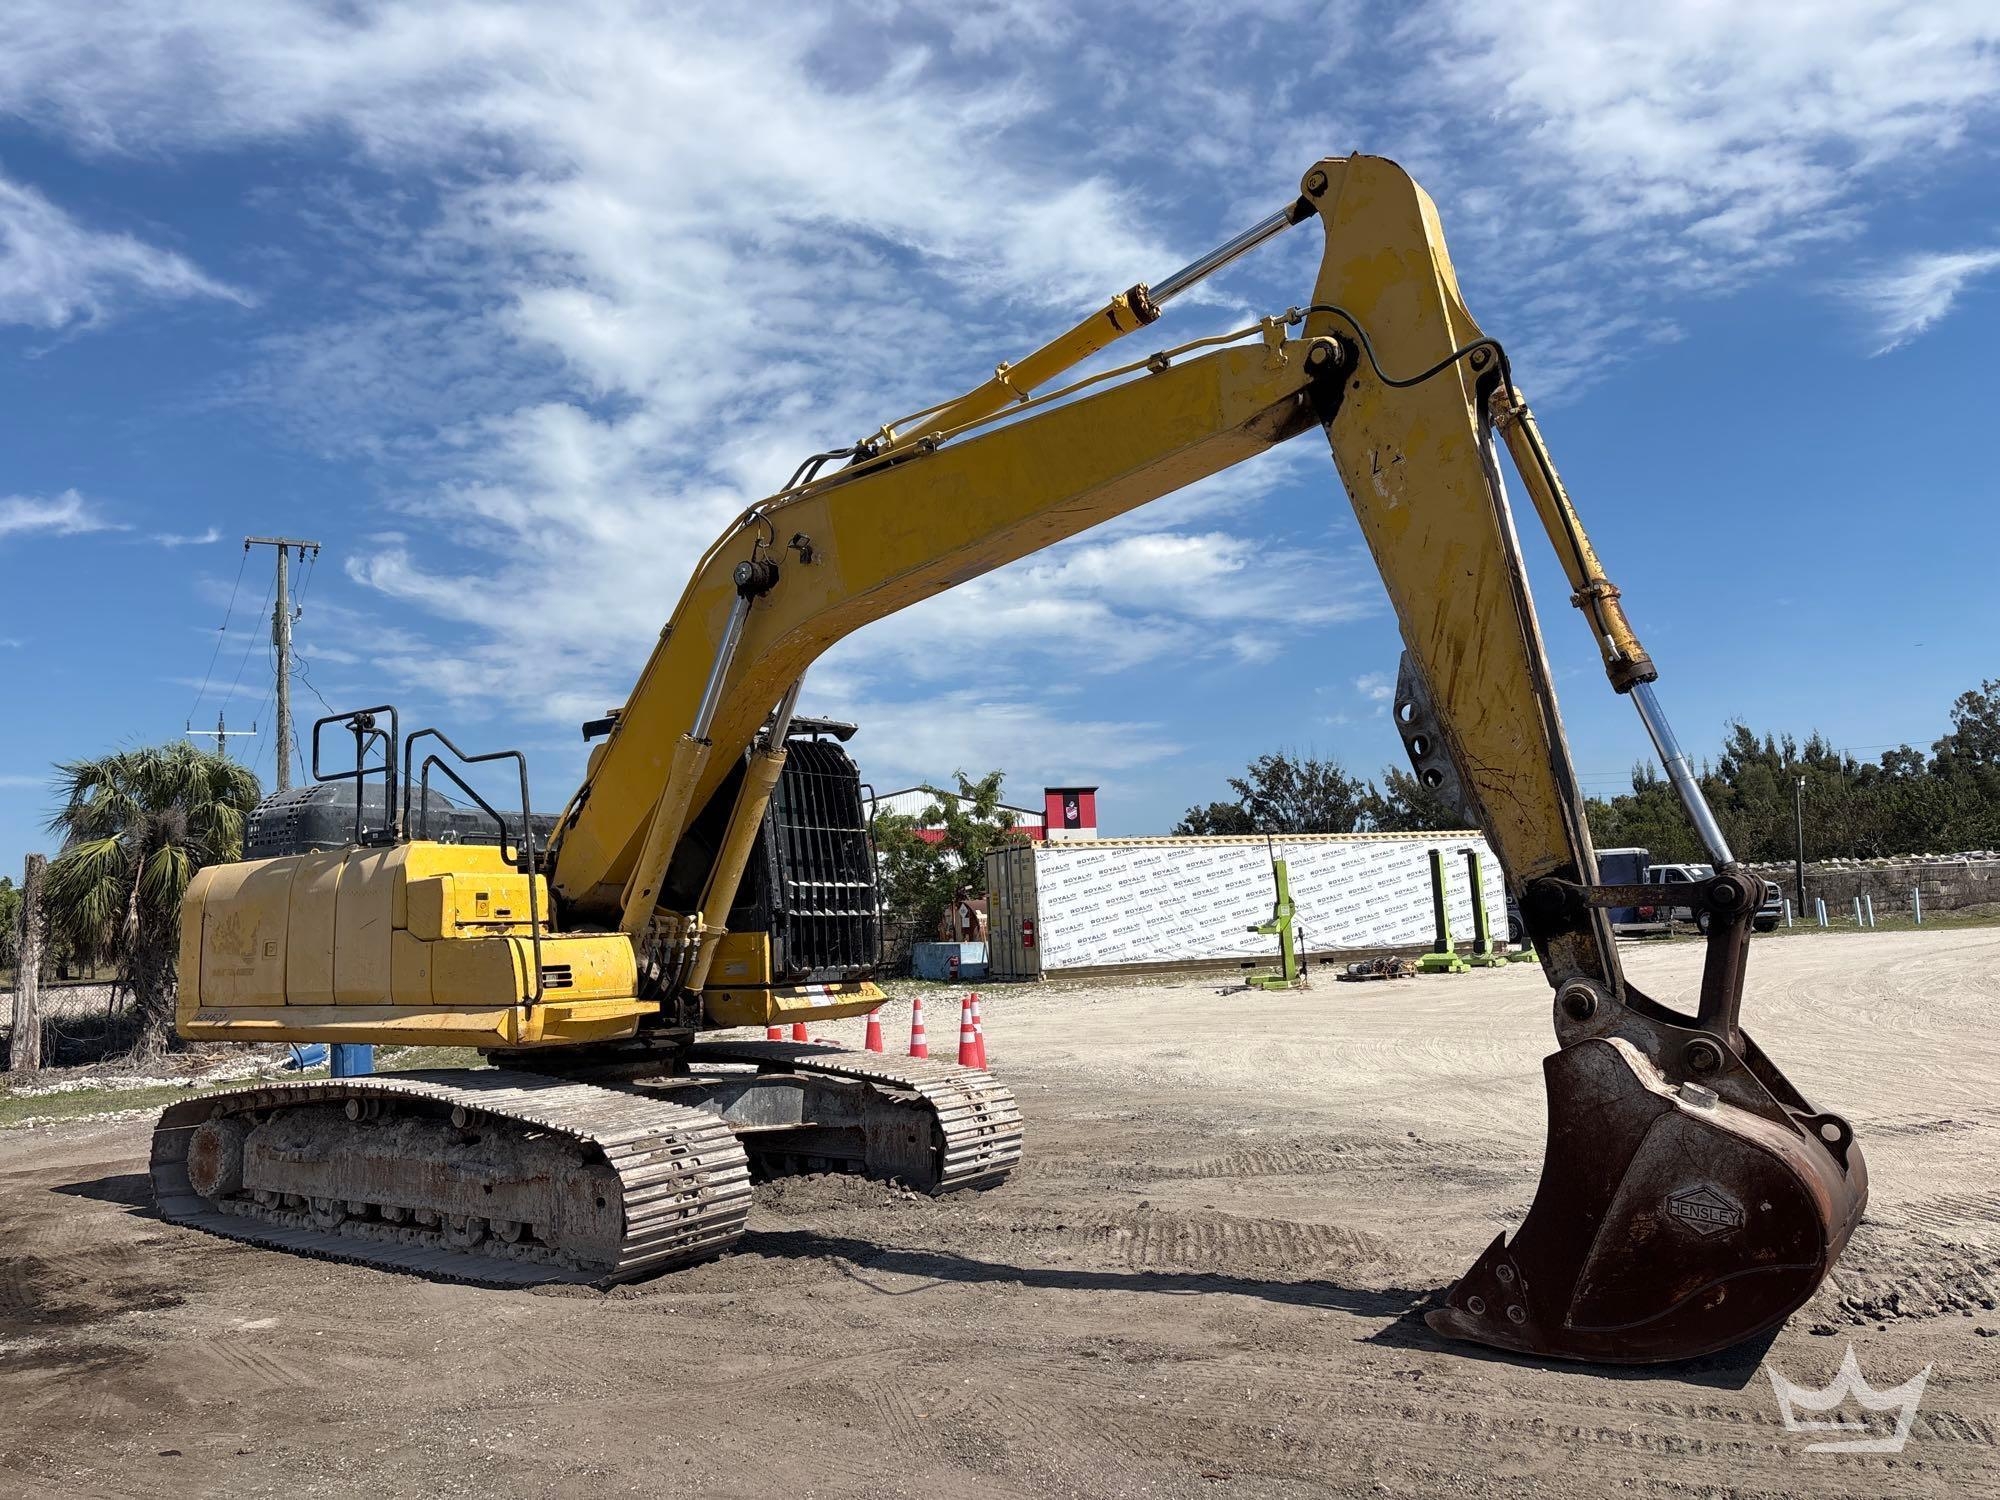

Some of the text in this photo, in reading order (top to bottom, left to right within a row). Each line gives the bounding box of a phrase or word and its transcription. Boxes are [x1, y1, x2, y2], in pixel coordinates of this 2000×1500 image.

[1219, 851, 1240, 859] ROYAL
[1207, 869, 1228, 878] ROYAL
[1192, 888, 1214, 896] ROYAL
[1246, 889, 1267, 897] ROYAL
[1349, 886, 1368, 894] ROYAL
[1048, 895, 1070, 903] ROYAL
[1159, 897, 1181, 905] ROYAL
[1213, 898, 1234, 906] ROYAL
[1071, 905, 1092, 913] ROYAL
[1125, 906, 1147, 914] ROYAL
[1232, 908, 1254, 916] ROYAL
[1091, 916, 1113, 924] ROYAL
[1147, 916, 1168, 924] ROYAL
[1200, 917, 1220, 925] ROYAL
[1056, 925, 1078, 933] ROYAL
[1113, 925, 1135, 933] ROYAL
[1166, 926, 1188, 934] ROYAL
[1221, 926, 1242, 934] ROYAL
[1078, 935, 1100, 943] ROYAL
[1132, 935, 1153, 944] ROYAL
[1240, 936, 1261, 944] ROYAL
[1098, 945, 1120, 953] ROYAL
[1154, 945, 1176, 953] ROYAL
[1063, 955, 1085, 964] ROYAL
[1669, 1202, 1740, 1225] HENSLEY
